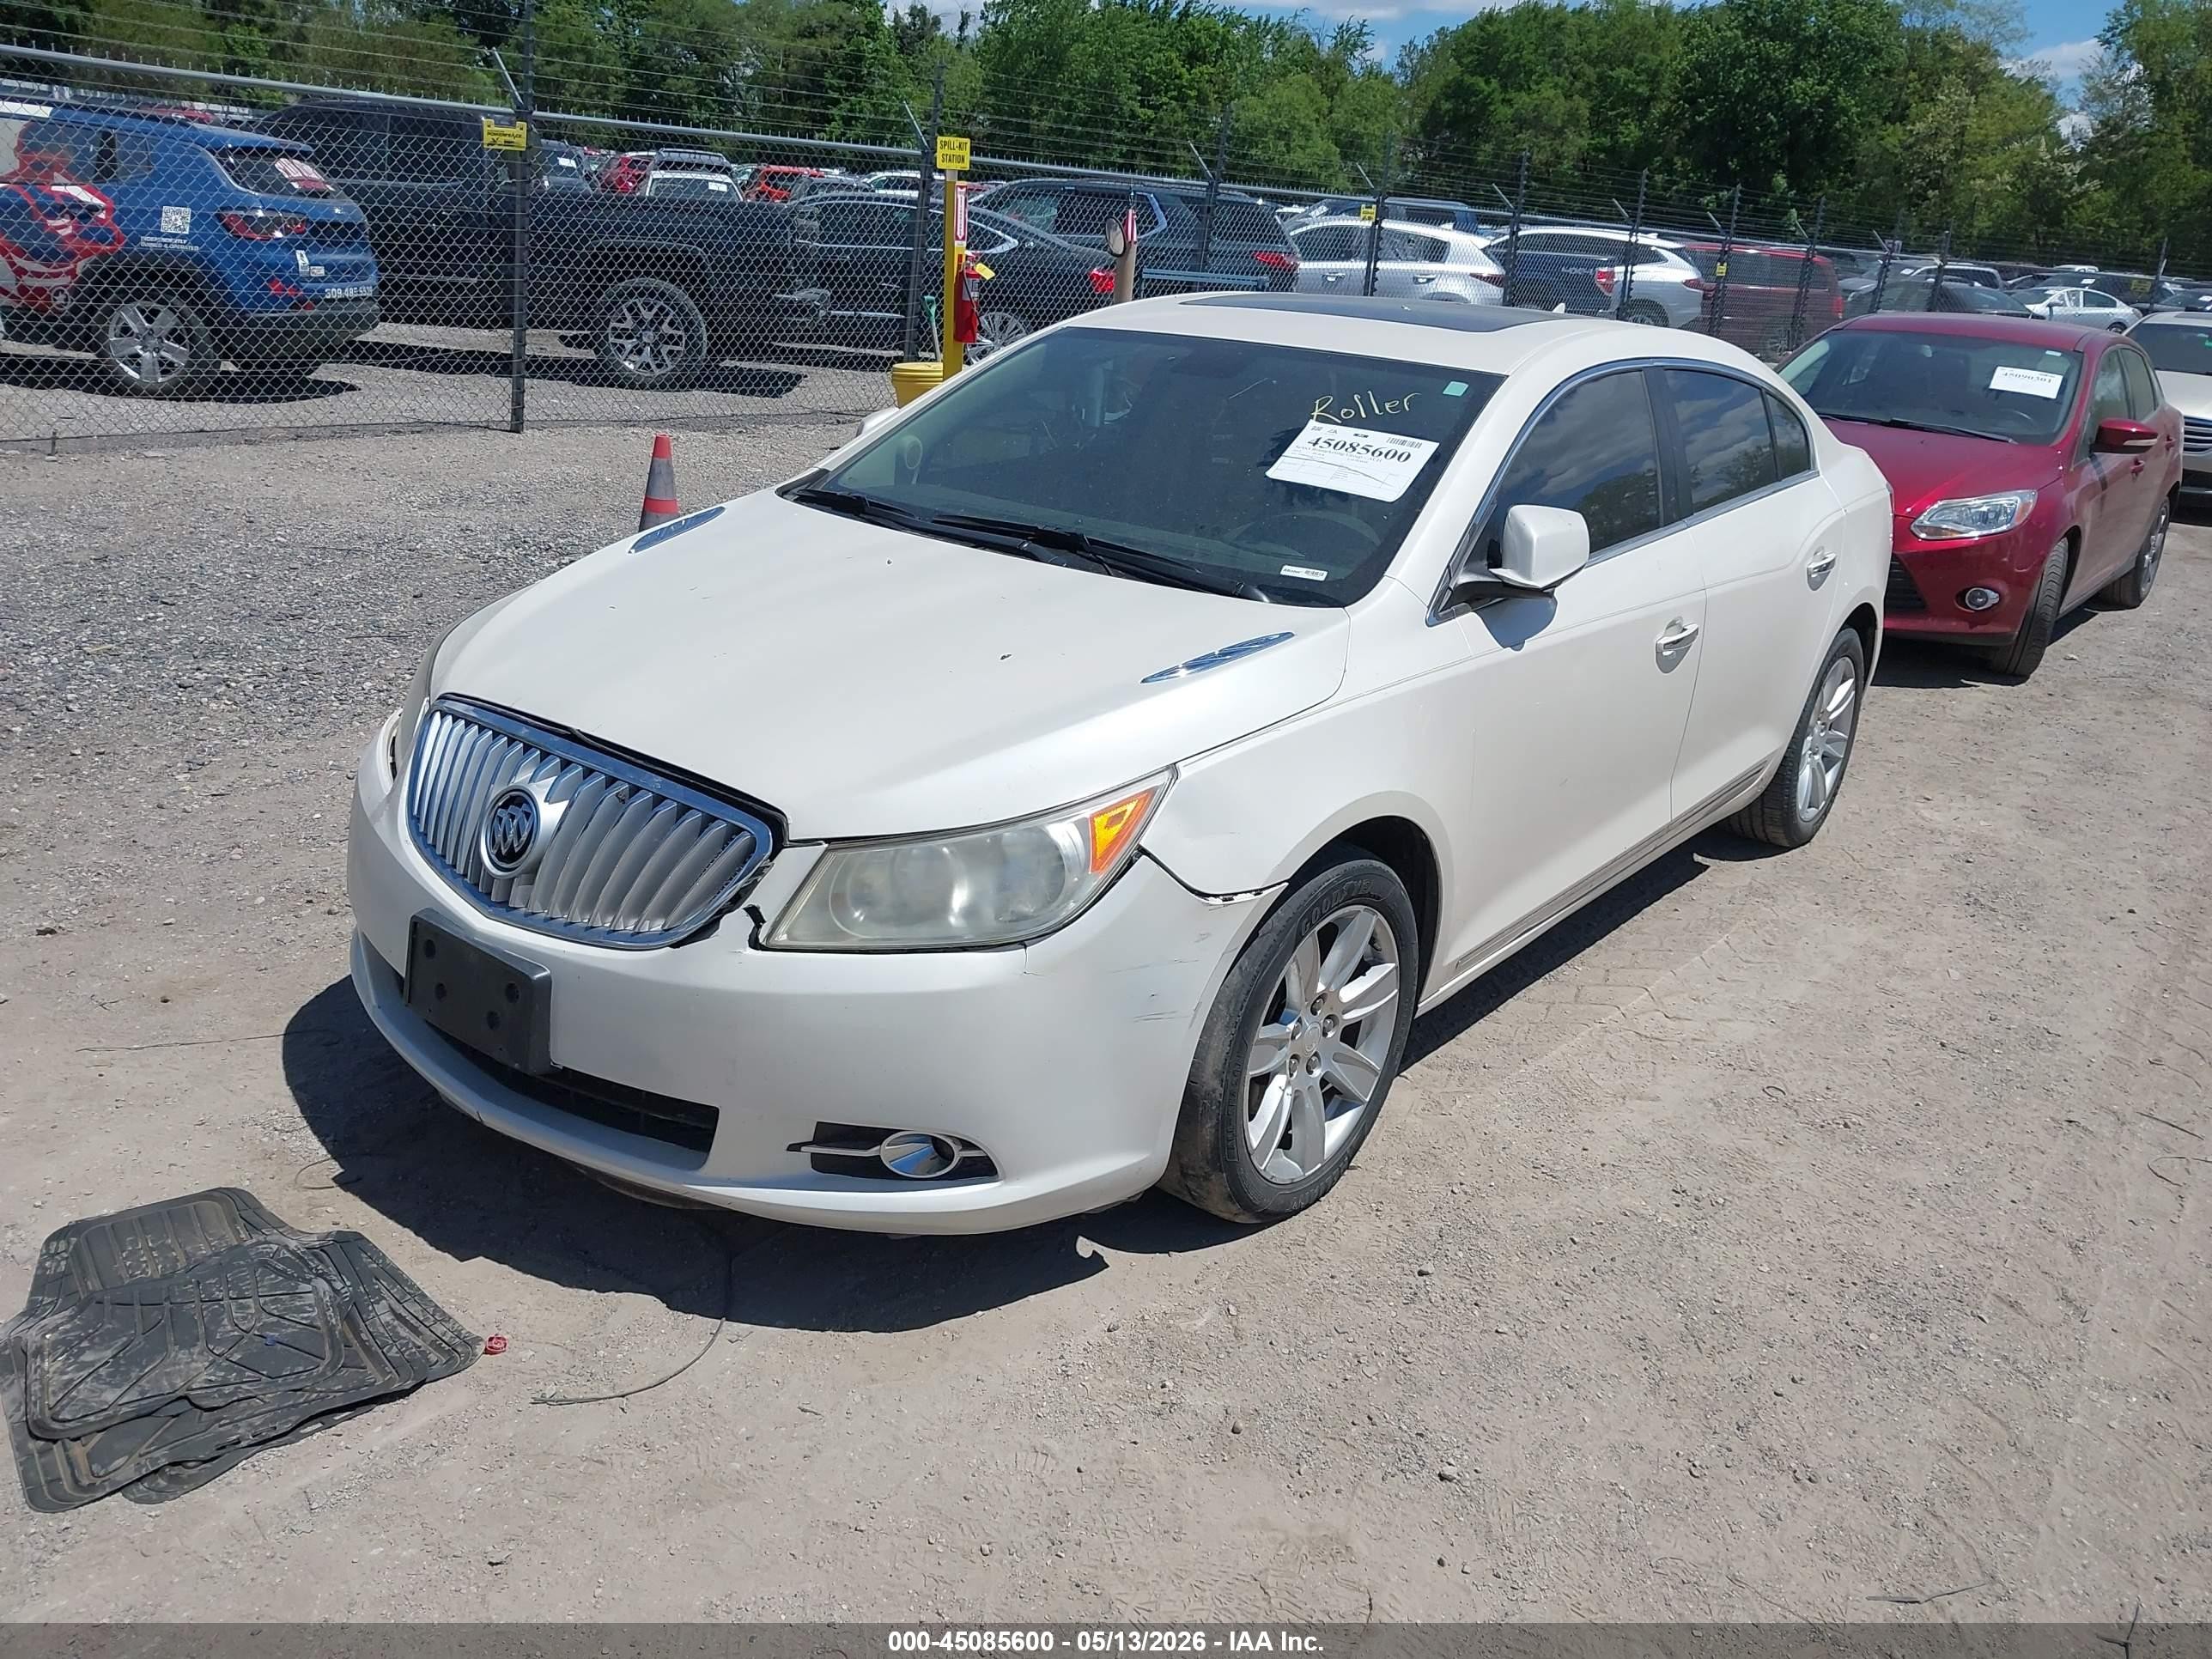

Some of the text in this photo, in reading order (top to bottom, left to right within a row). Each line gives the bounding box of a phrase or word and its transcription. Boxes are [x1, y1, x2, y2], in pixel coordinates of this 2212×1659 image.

[941, 153, 965, 164] STATION
[1310, 390, 1422, 423] Roller
[1307, 436, 1412, 463] 45085600
